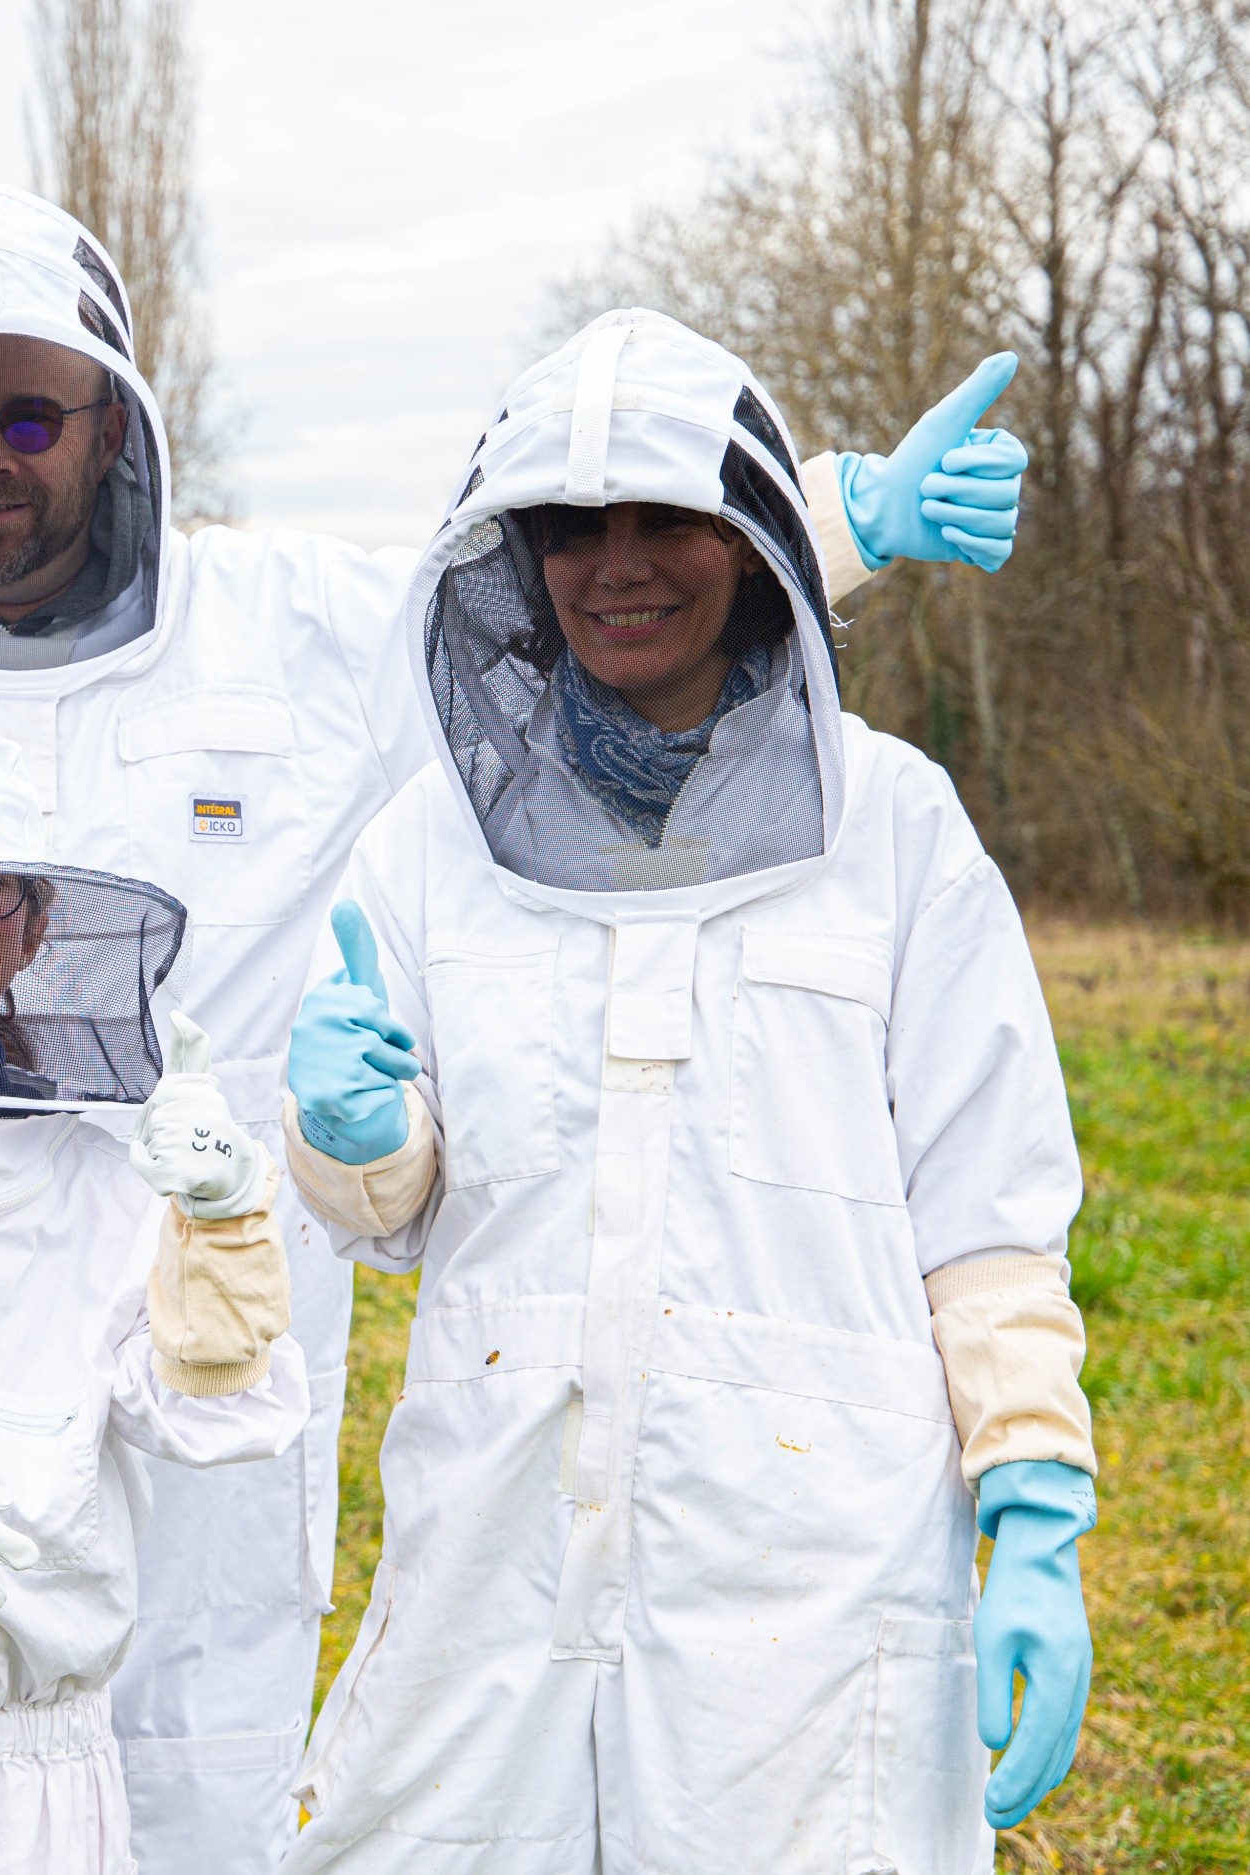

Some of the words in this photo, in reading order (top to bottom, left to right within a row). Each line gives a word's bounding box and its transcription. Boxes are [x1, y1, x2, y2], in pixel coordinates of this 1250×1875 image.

[196, 803, 237, 816] INTÉGRAL
[209, 821, 236, 832] ICKO
[191, 1127, 211, 1152] CE
[214, 1139, 233, 1158] 5
